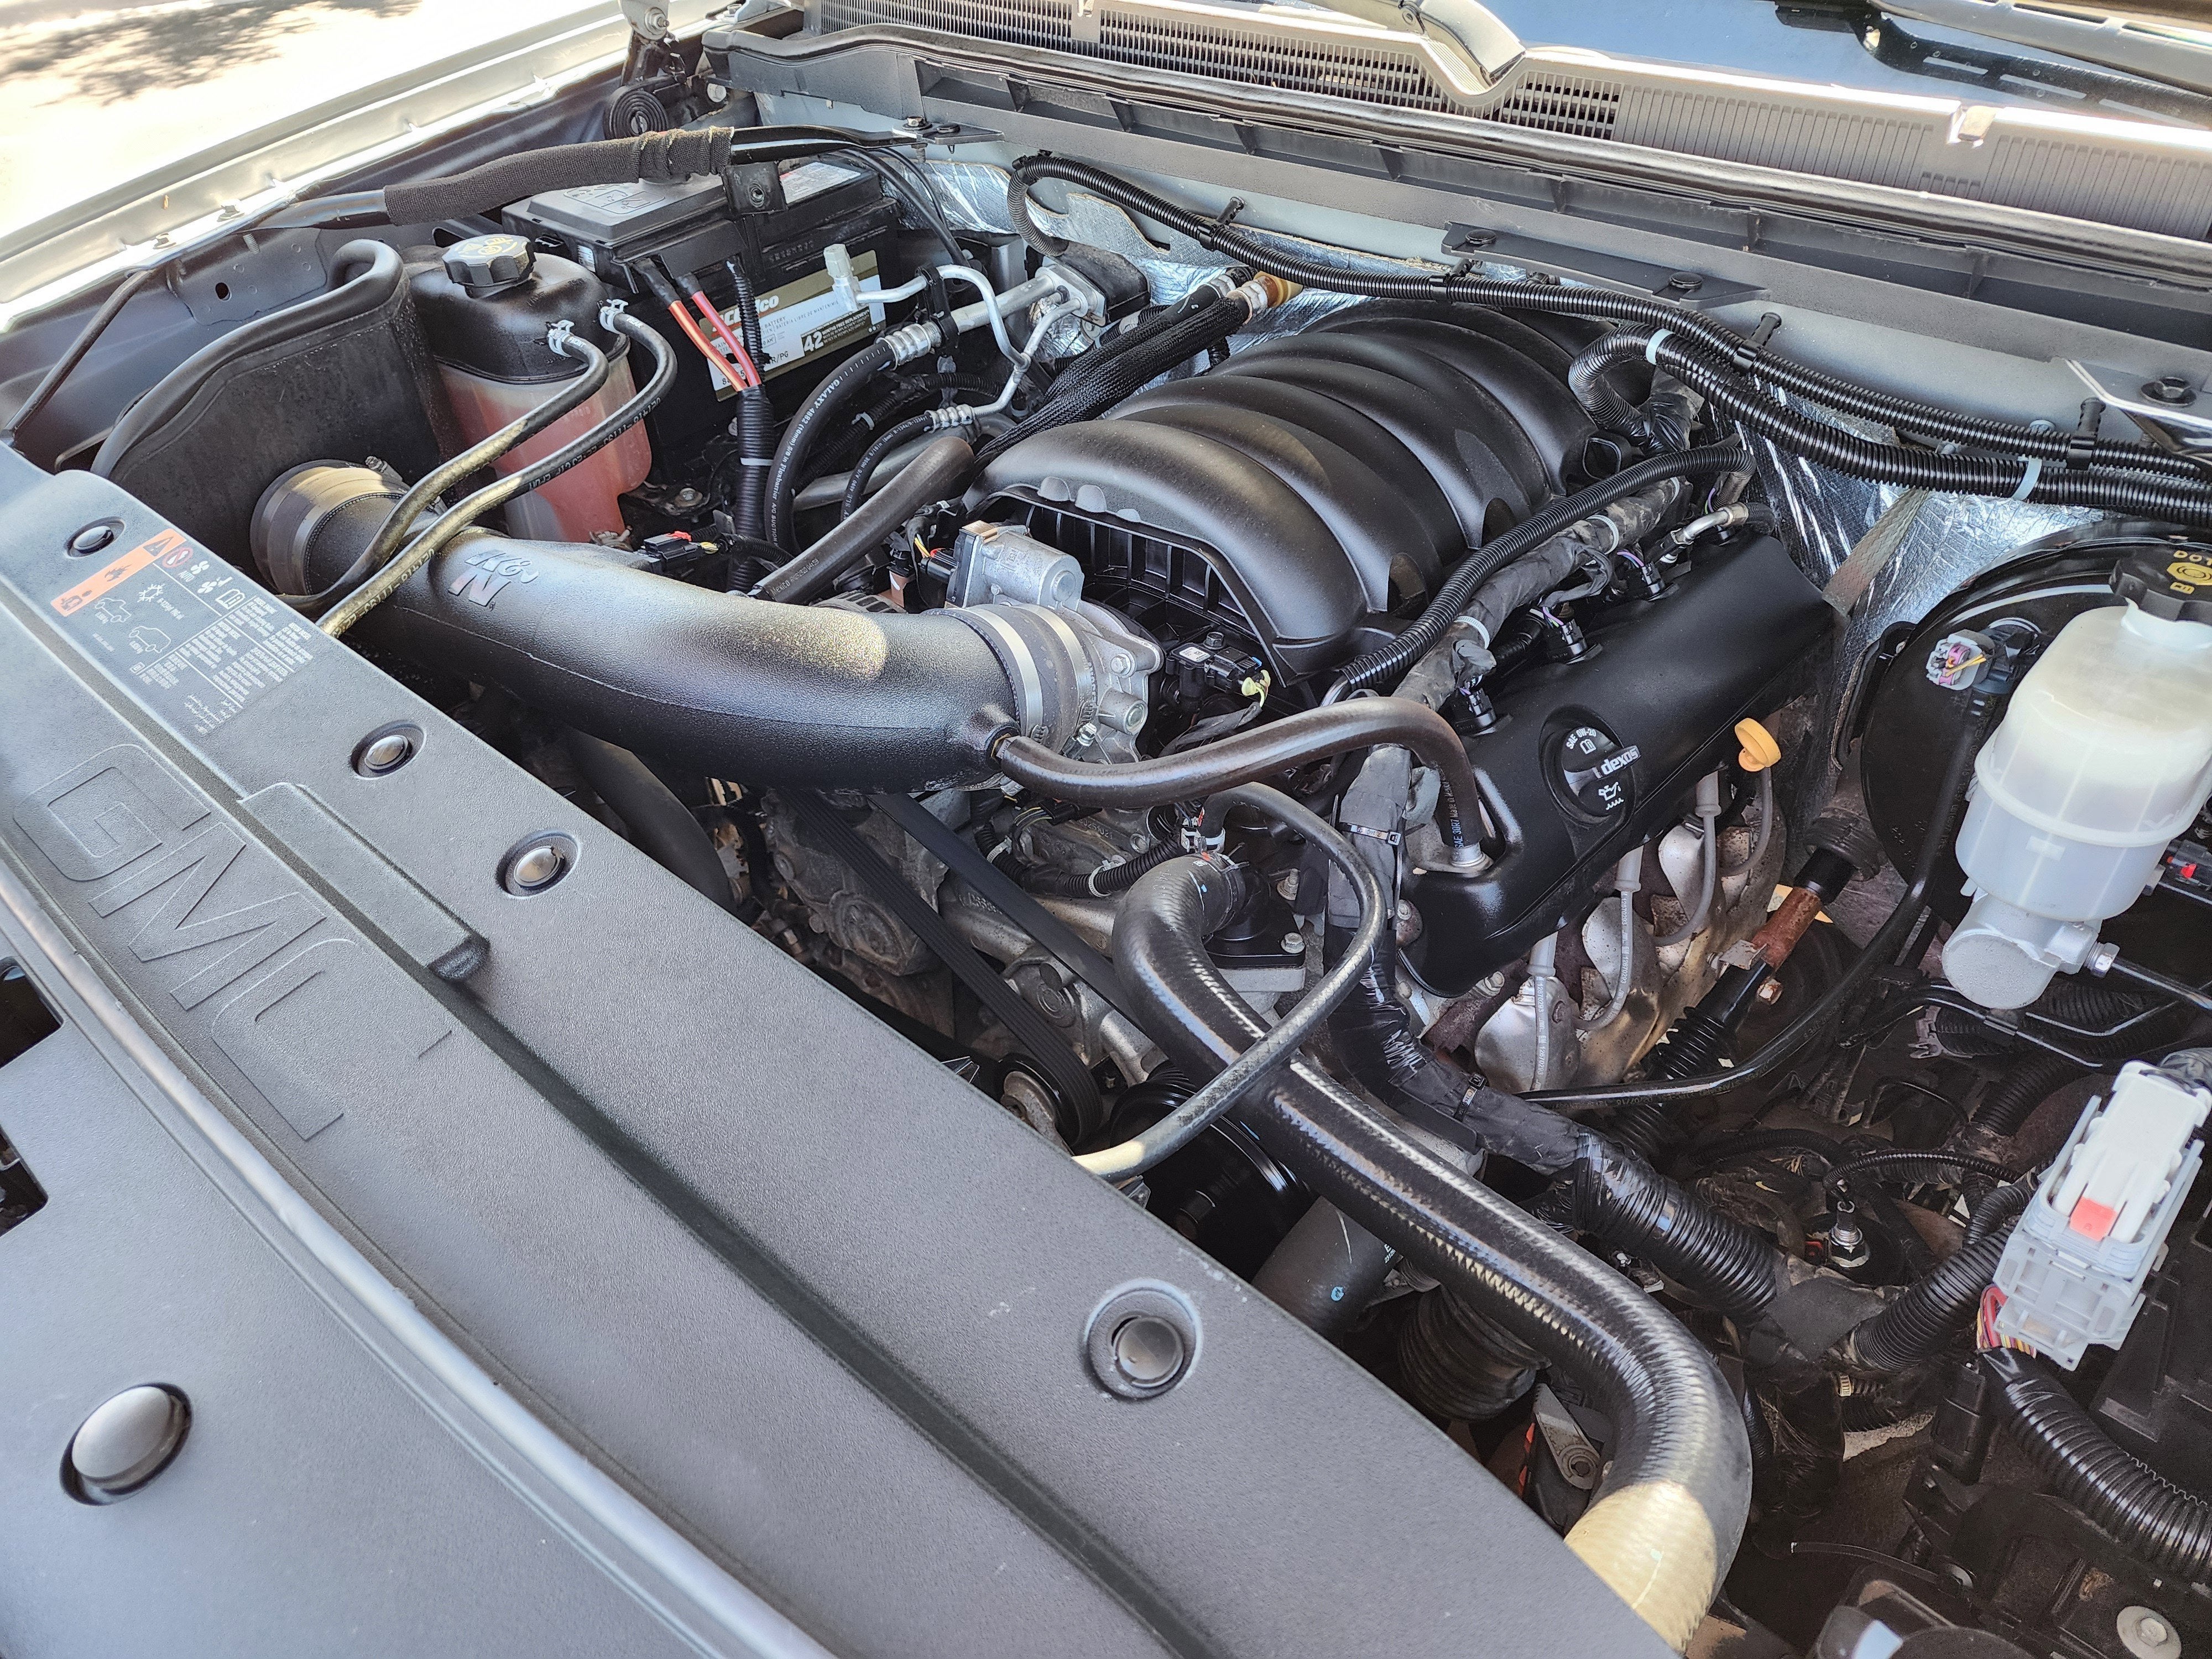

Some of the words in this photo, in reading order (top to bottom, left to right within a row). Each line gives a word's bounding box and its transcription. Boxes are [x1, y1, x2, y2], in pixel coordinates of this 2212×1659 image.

[627, 316, 643, 328] REAR
[567, 337, 587, 348] FRONT
[804, 331, 823, 352] 42
[813, 378, 840, 409] GALAXY
[178, 570, 196, 583] AUTO
[1566, 733, 1578, 750] SAE
[1576, 727, 1597, 738] 0W-20
[1600, 749, 1639, 774] dexos
[1447, 804, 1458, 817] Made
[1450, 819, 1462, 834] 30R7
[1453, 835, 1464, 848] SAE
[14, 744, 452, 1141] GMC
[1537, 1046, 1546, 1074] 12670293
